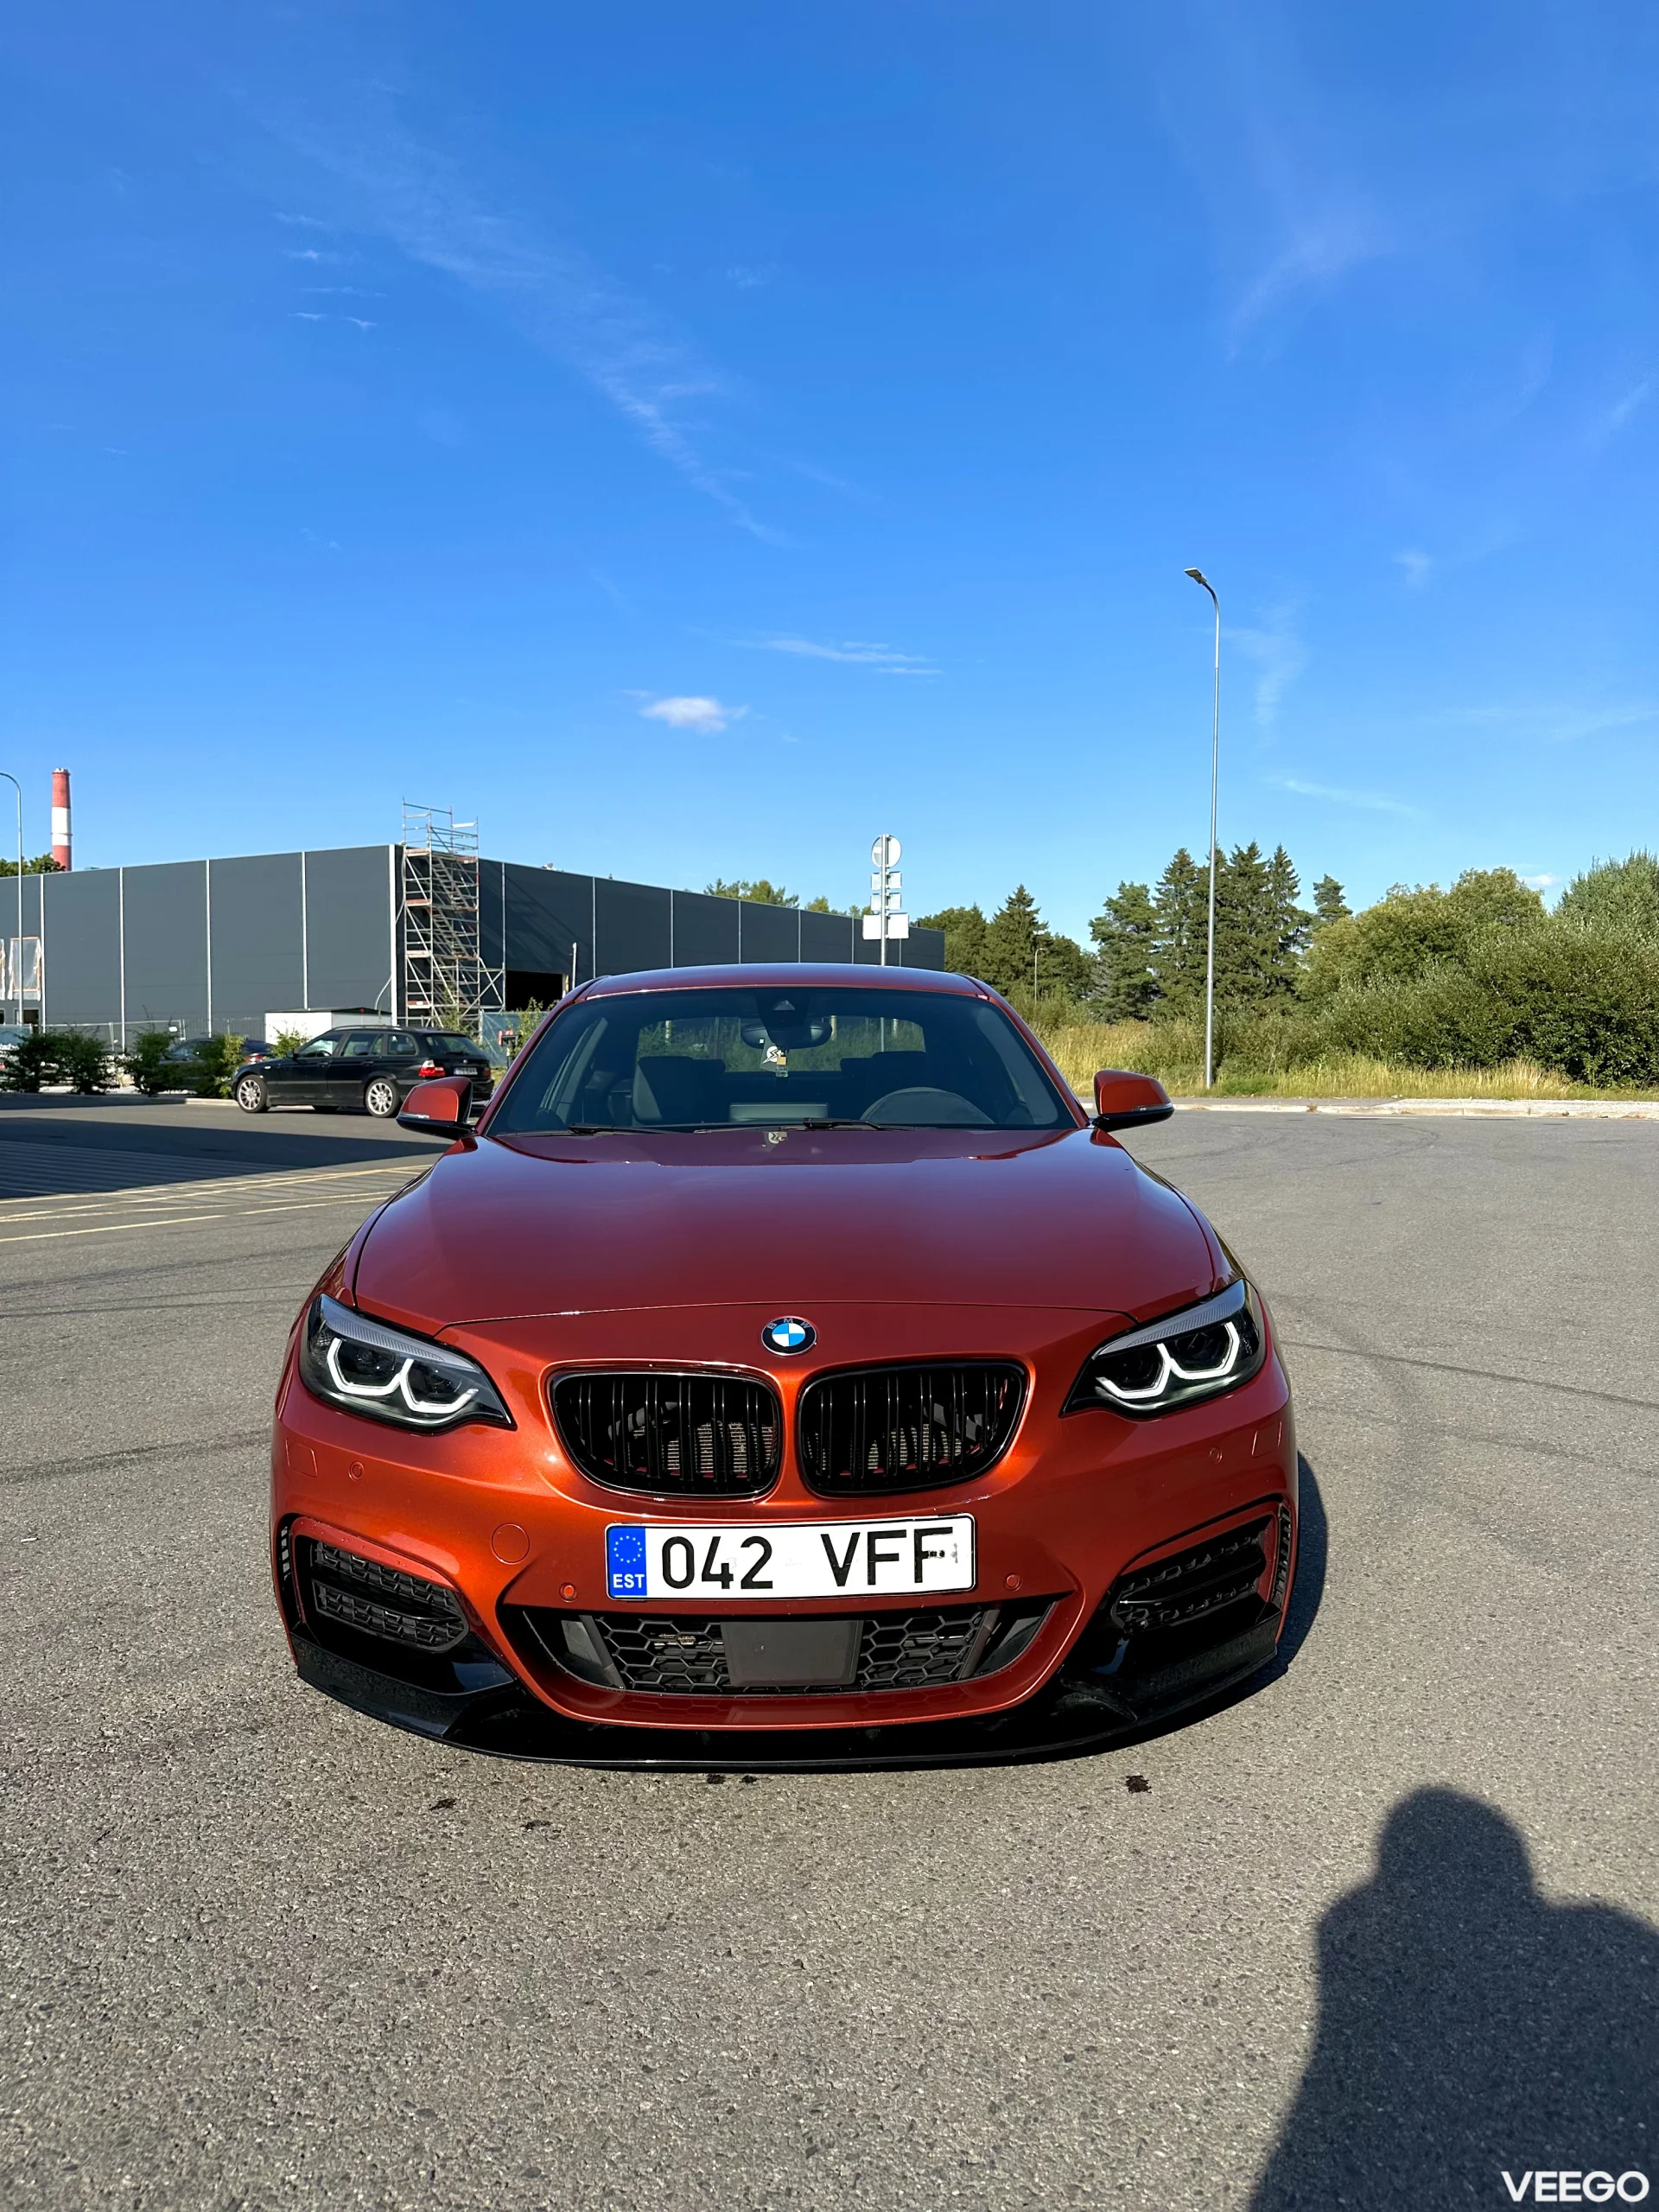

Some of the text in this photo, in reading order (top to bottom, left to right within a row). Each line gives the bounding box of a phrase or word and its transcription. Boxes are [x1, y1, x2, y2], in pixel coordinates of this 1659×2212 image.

[766, 1318, 811, 1330] BMW
[662, 1526, 954, 1590] 042 VFF
[613, 1573, 645, 1589] EST
